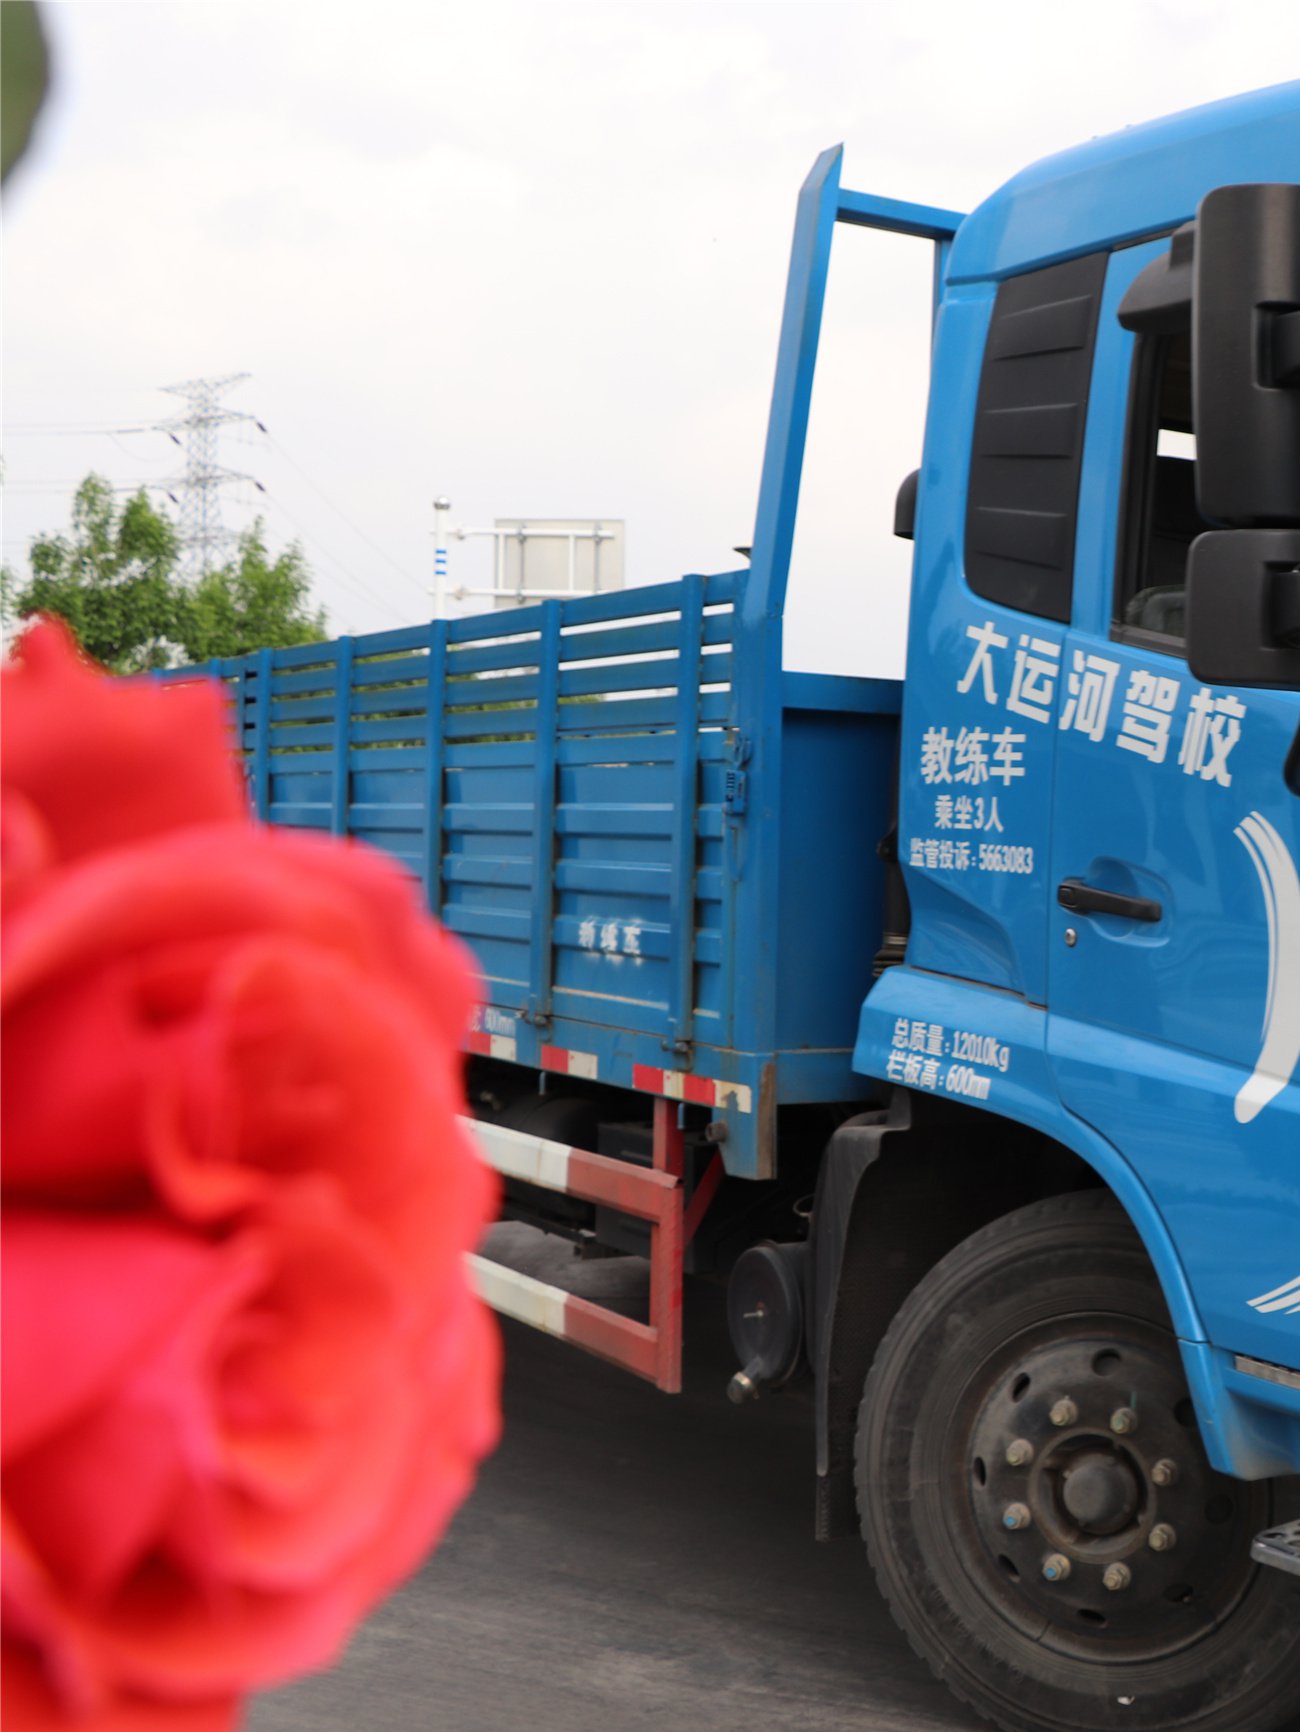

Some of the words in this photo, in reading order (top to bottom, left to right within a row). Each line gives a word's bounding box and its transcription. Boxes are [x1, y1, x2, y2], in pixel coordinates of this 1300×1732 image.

[957, 621, 1246, 787] 大运河驾校
[921, 726, 1026, 786] 教练车
[935, 795, 1004, 832] 乘坐3人
